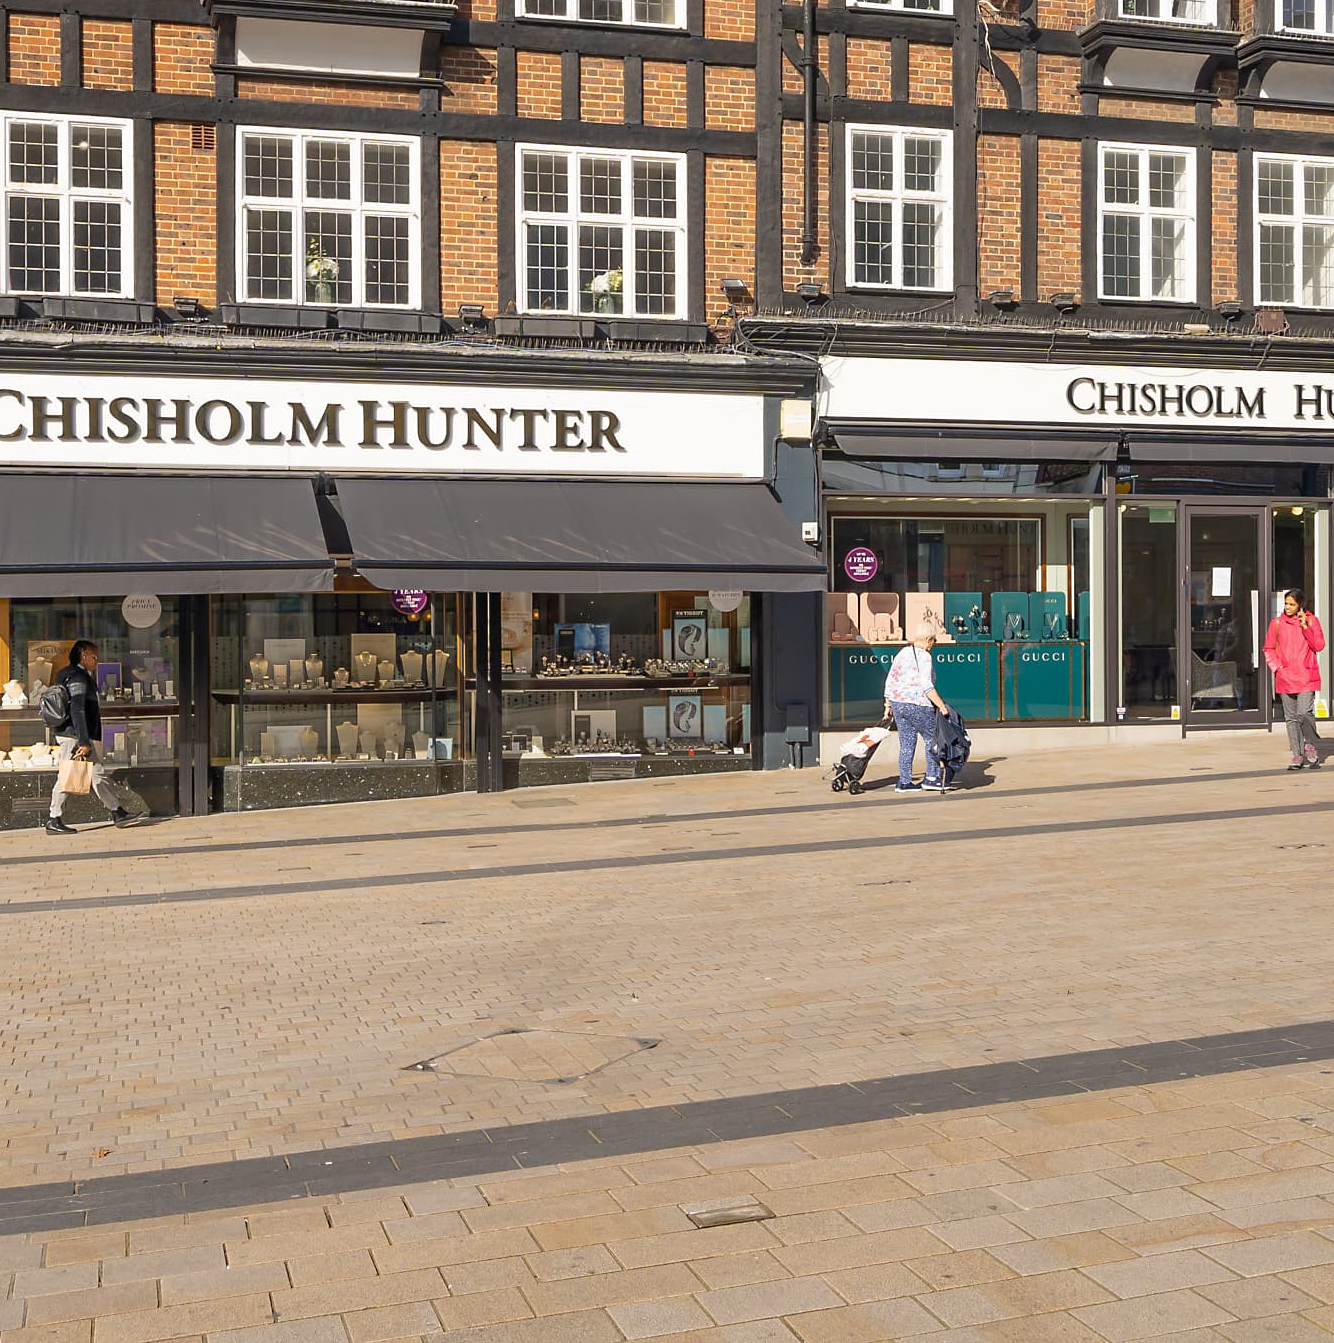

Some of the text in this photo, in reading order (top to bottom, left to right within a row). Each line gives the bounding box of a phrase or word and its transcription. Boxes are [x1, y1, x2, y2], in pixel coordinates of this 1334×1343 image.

[1067, 377, 1267, 419] CHISHOLM
[357, 399, 629, 454] HUNTER
[849, 653, 981, 664] GUCCI GUCCI
[1022, 651, 1066, 662] GUCCI
